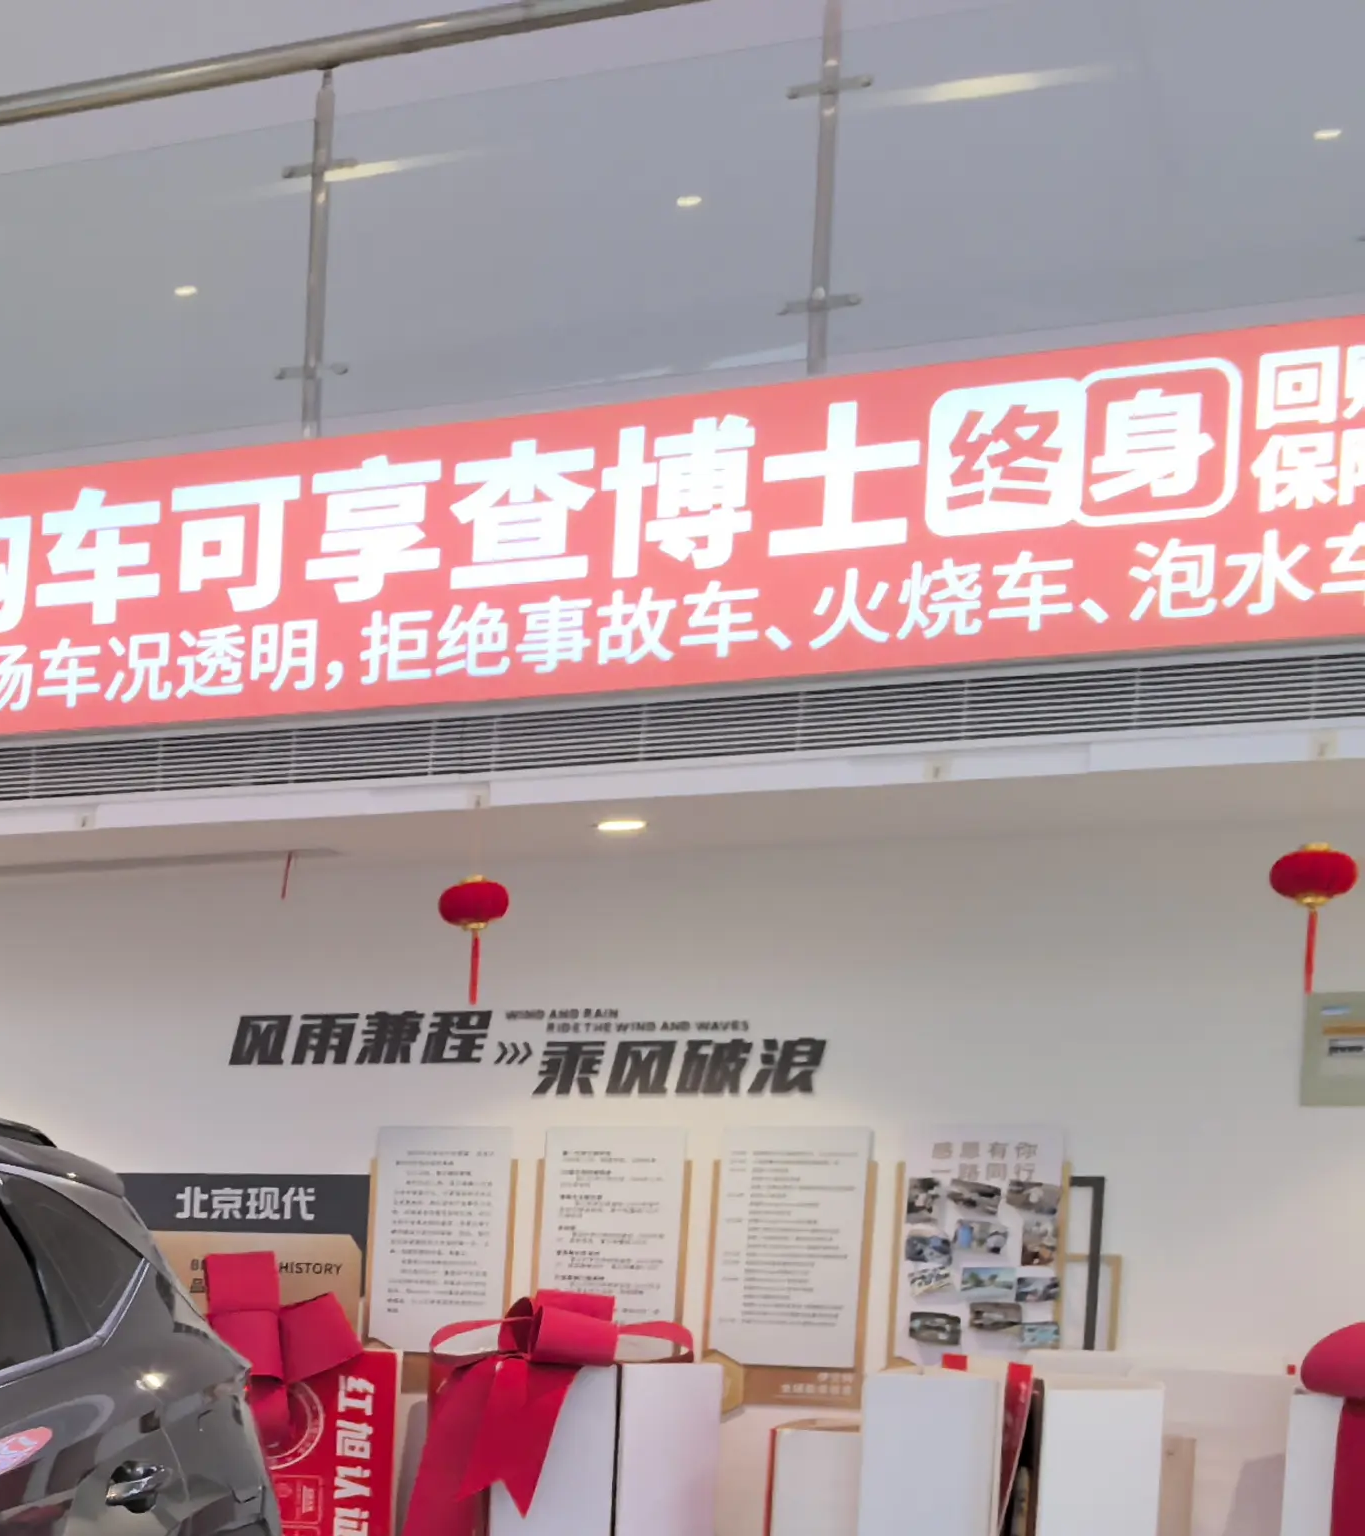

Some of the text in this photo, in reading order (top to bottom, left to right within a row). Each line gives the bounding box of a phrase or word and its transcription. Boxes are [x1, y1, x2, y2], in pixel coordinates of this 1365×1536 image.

[549, 1009, 579, 1019] AND
[583, 1008, 618, 1019] RAIN
[229, 1010, 492, 1067] 风雨兼程
[546, 1020, 749, 1033] RIDE THE WIND AND WAVES
[531, 1038, 827, 1097] 乘风破浪
[175, 1186, 316, 1221] 北京现代
[279, 1261, 343, 1276] HISTORY
